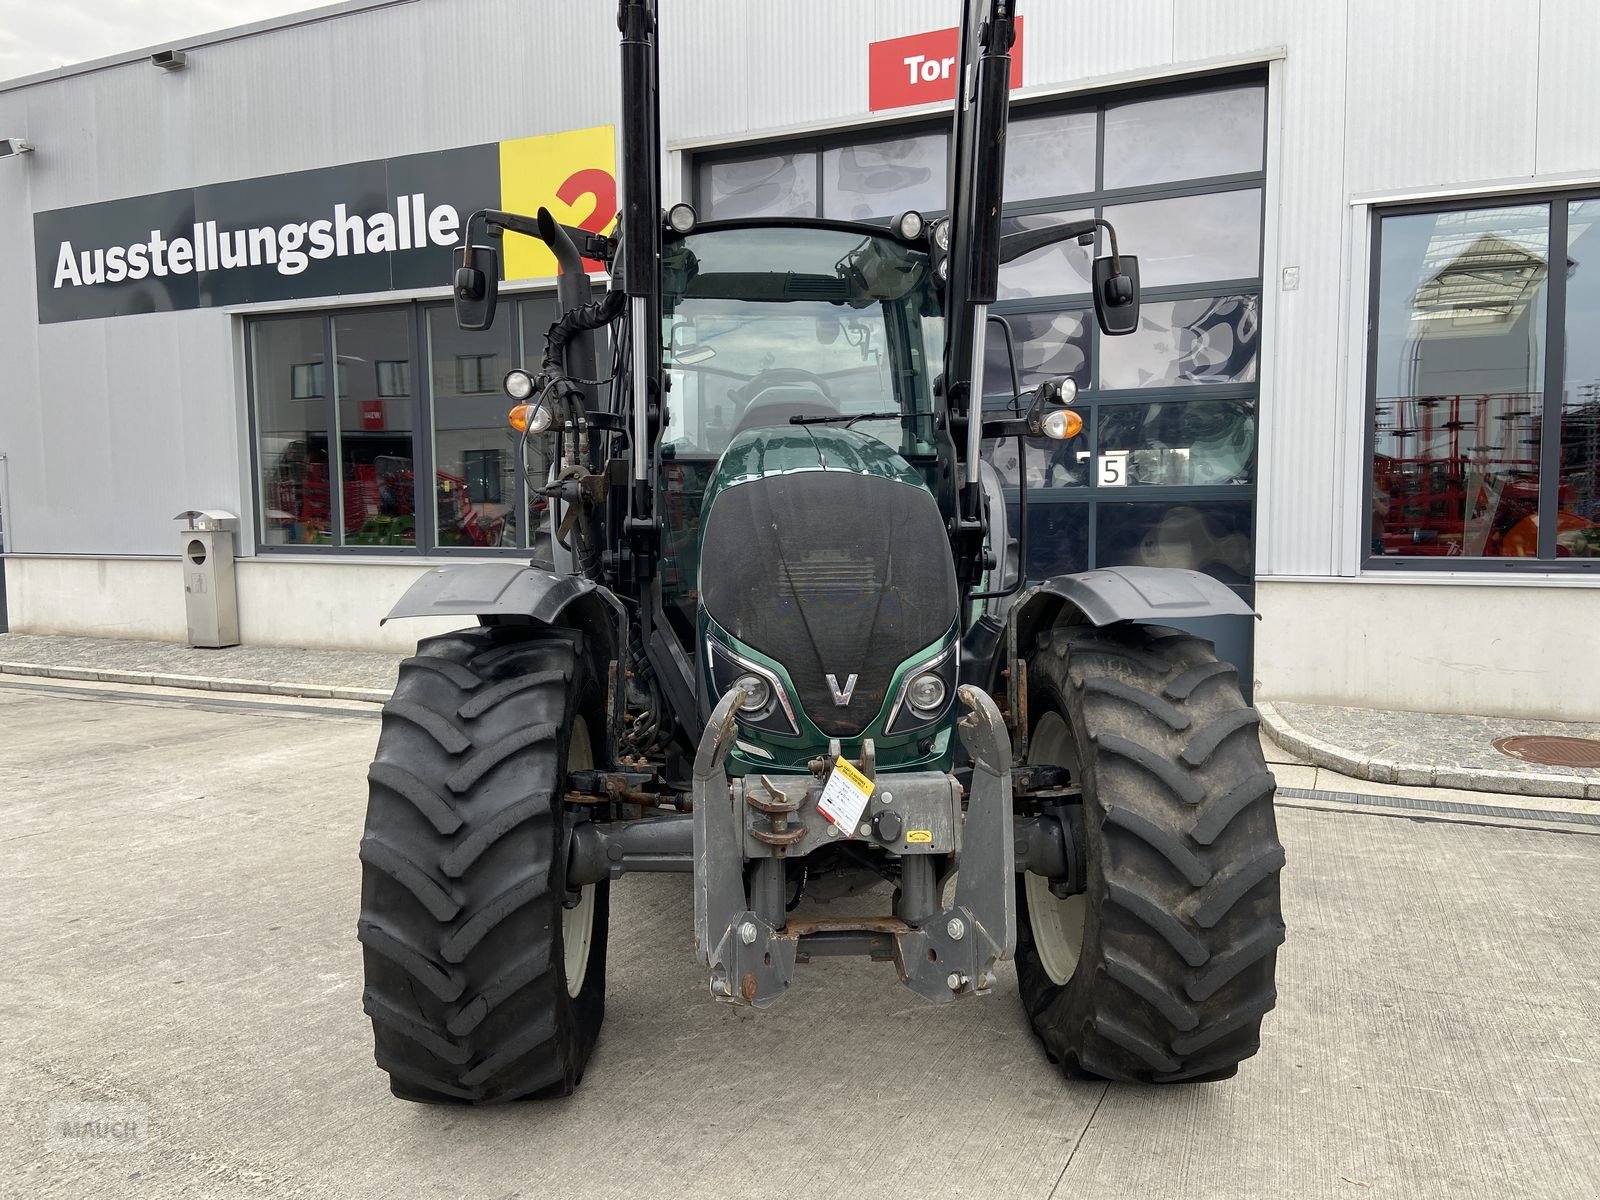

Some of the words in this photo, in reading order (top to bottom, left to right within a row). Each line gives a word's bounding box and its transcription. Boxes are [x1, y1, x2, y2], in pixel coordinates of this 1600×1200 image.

[903, 54, 956, 85] Tor
[53, 192, 460, 289] Ausstellungshalle
[555, 168, 617, 276] 2
[1103, 460, 1119, 484] 5
[825, 673, 859, 707] V
